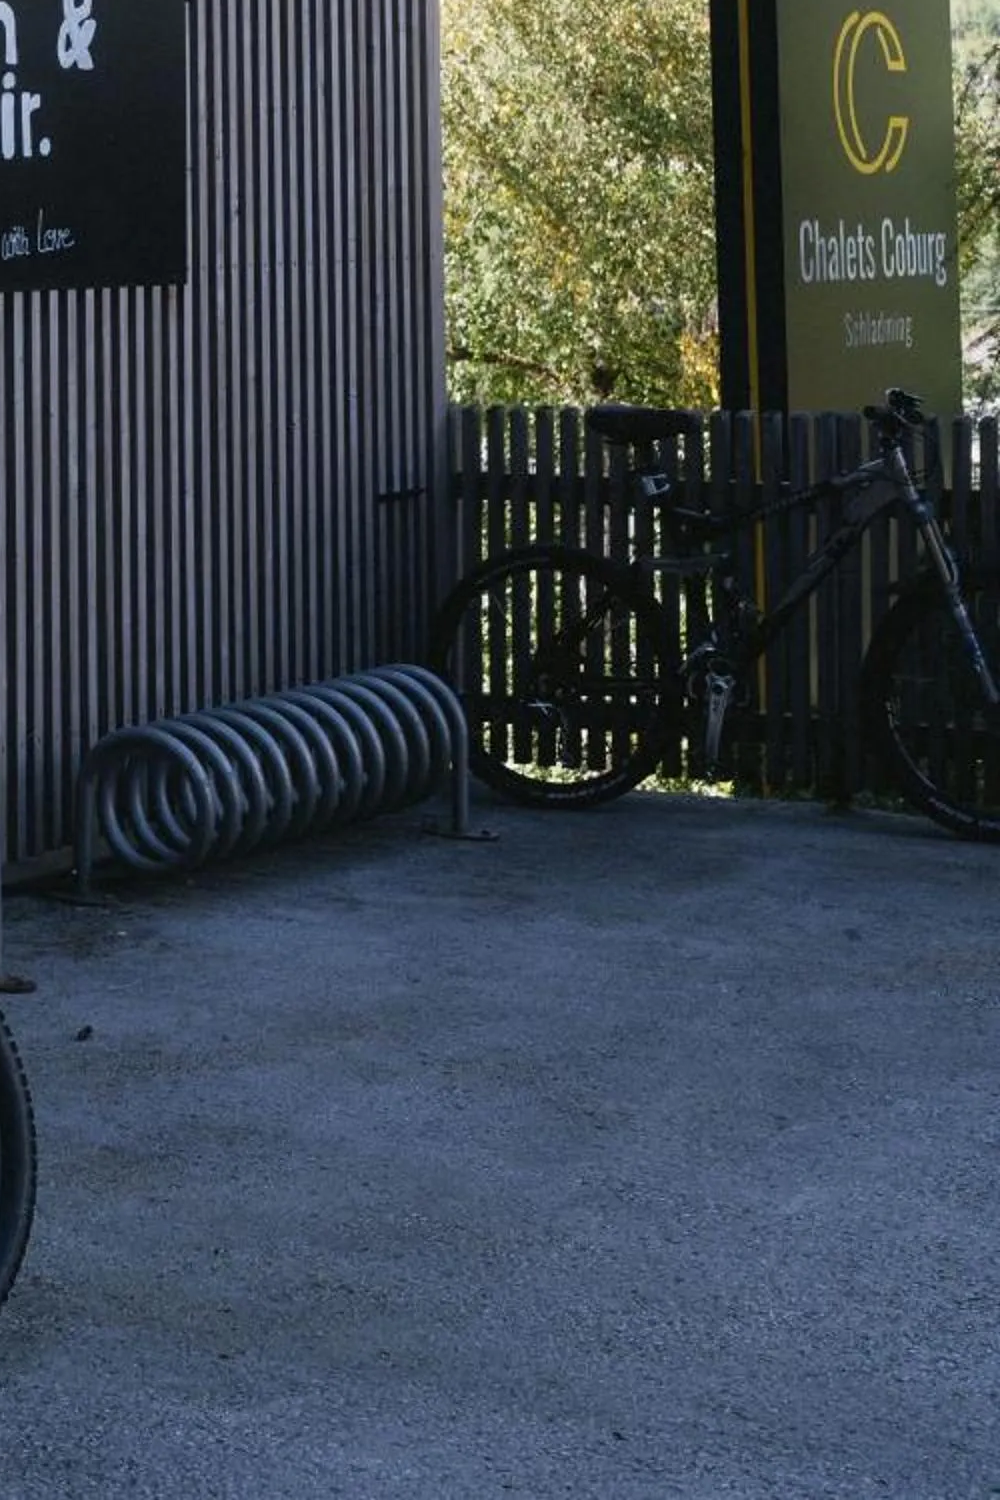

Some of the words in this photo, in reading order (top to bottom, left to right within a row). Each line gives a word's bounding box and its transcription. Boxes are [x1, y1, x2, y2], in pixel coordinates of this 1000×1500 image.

[1, 225, 32, 261] with
[799, 218, 875, 284] Chalets
[881, 216, 947, 286] Coburg
[844, 310, 913, 349] Schladming
